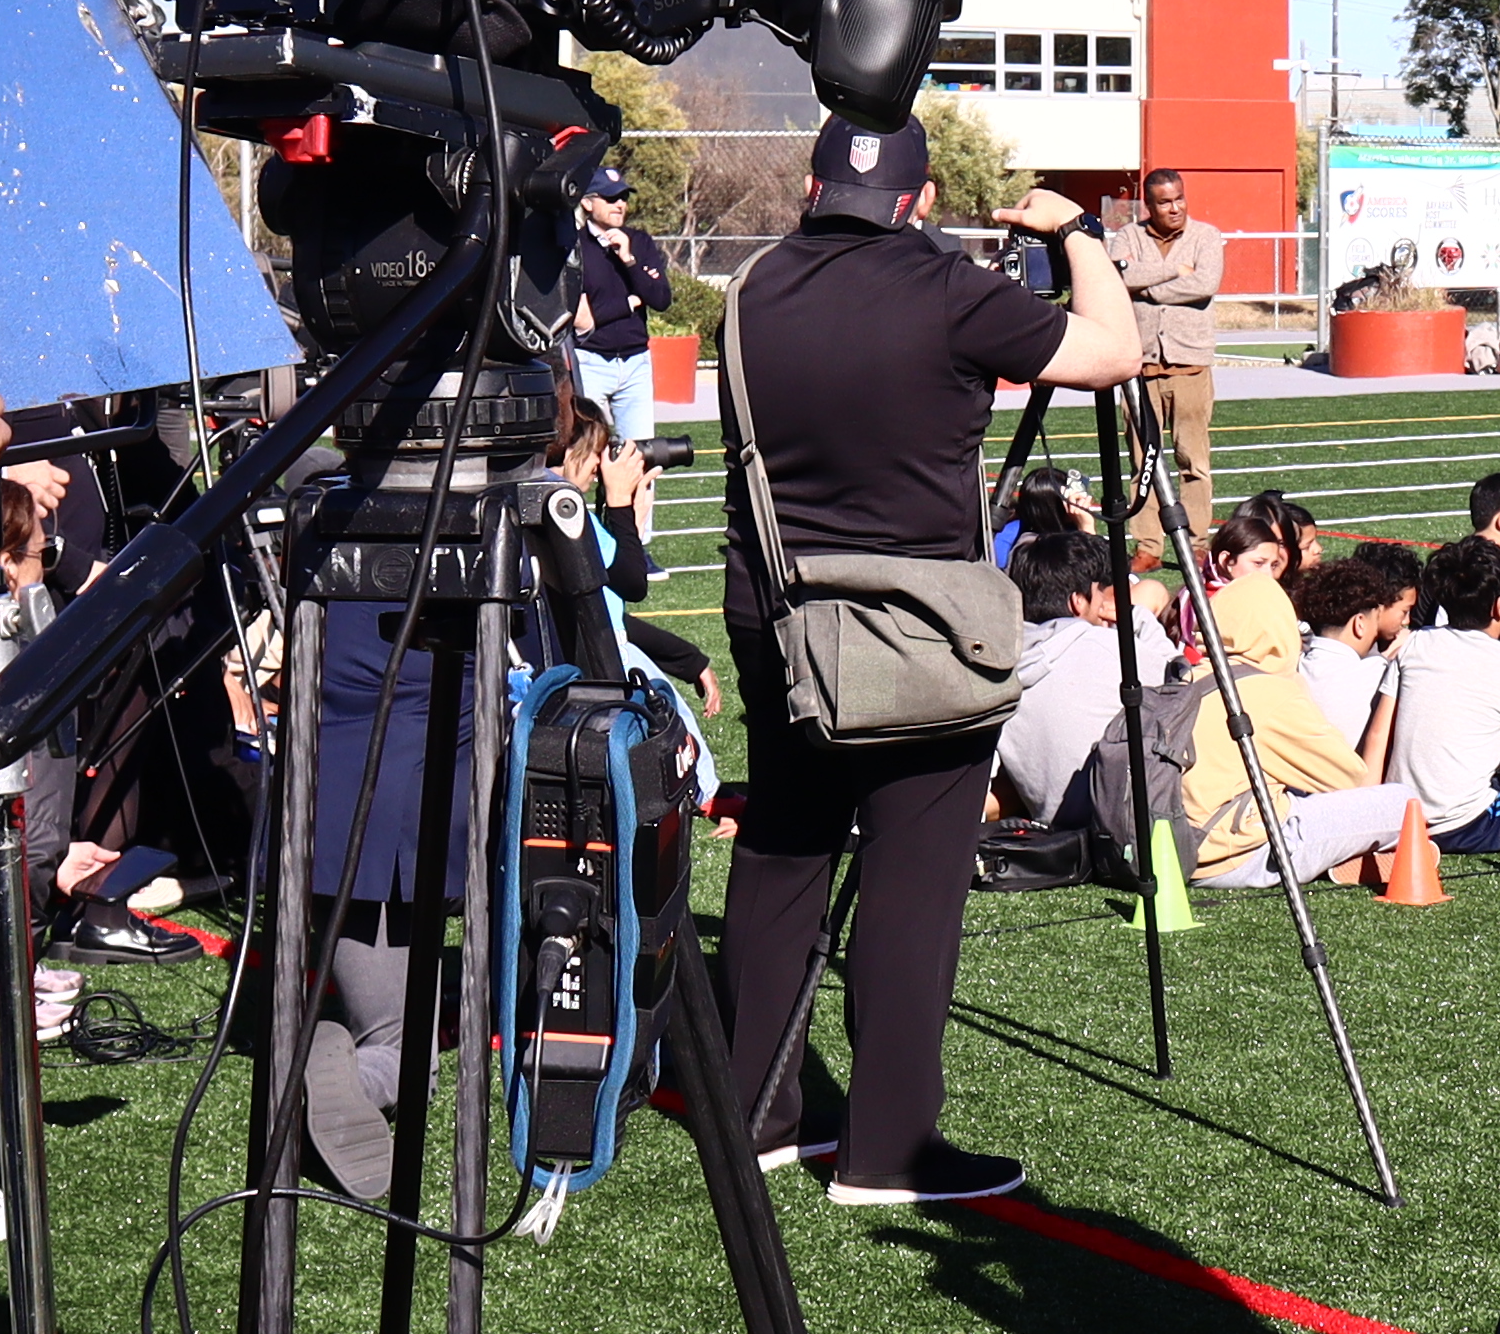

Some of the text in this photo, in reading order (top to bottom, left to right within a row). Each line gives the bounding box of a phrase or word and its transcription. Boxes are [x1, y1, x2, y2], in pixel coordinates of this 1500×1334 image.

[853, 138, 878, 152] USA
[1367, 197, 1408, 206] AMERICA
[1367, 207, 1408, 218] SCORES
[370, 262, 405, 278] VIDEO
[1139, 443, 1156, 498] SONY
